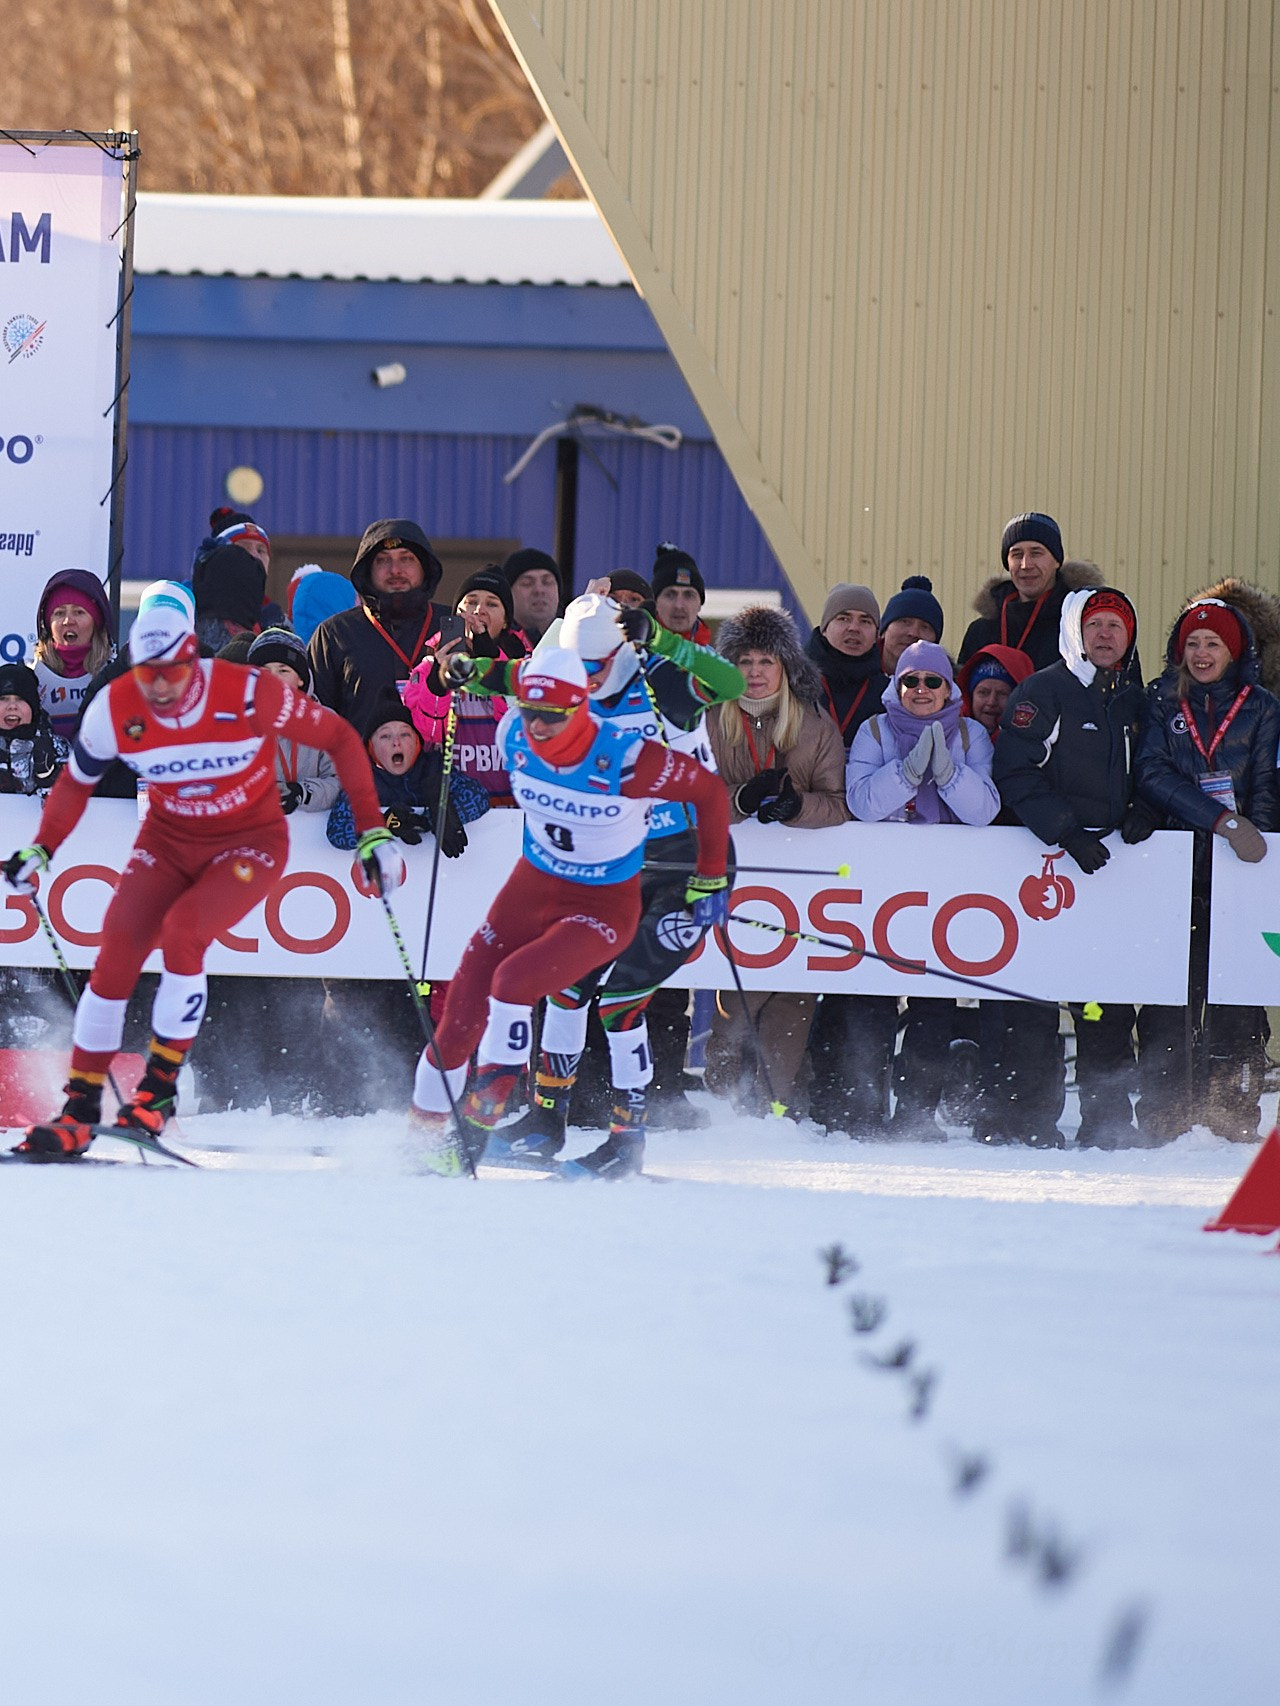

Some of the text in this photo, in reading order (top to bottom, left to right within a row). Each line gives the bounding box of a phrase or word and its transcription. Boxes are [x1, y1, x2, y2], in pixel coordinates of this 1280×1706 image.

[450, 744, 506, 772] ЕРВИ
[521, 788, 620, 818] ФОСАГРО
[683, 885, 1020, 977] OSCO
[181, 992, 204, 1023] 2
[508, 1020, 529, 1051] 9
